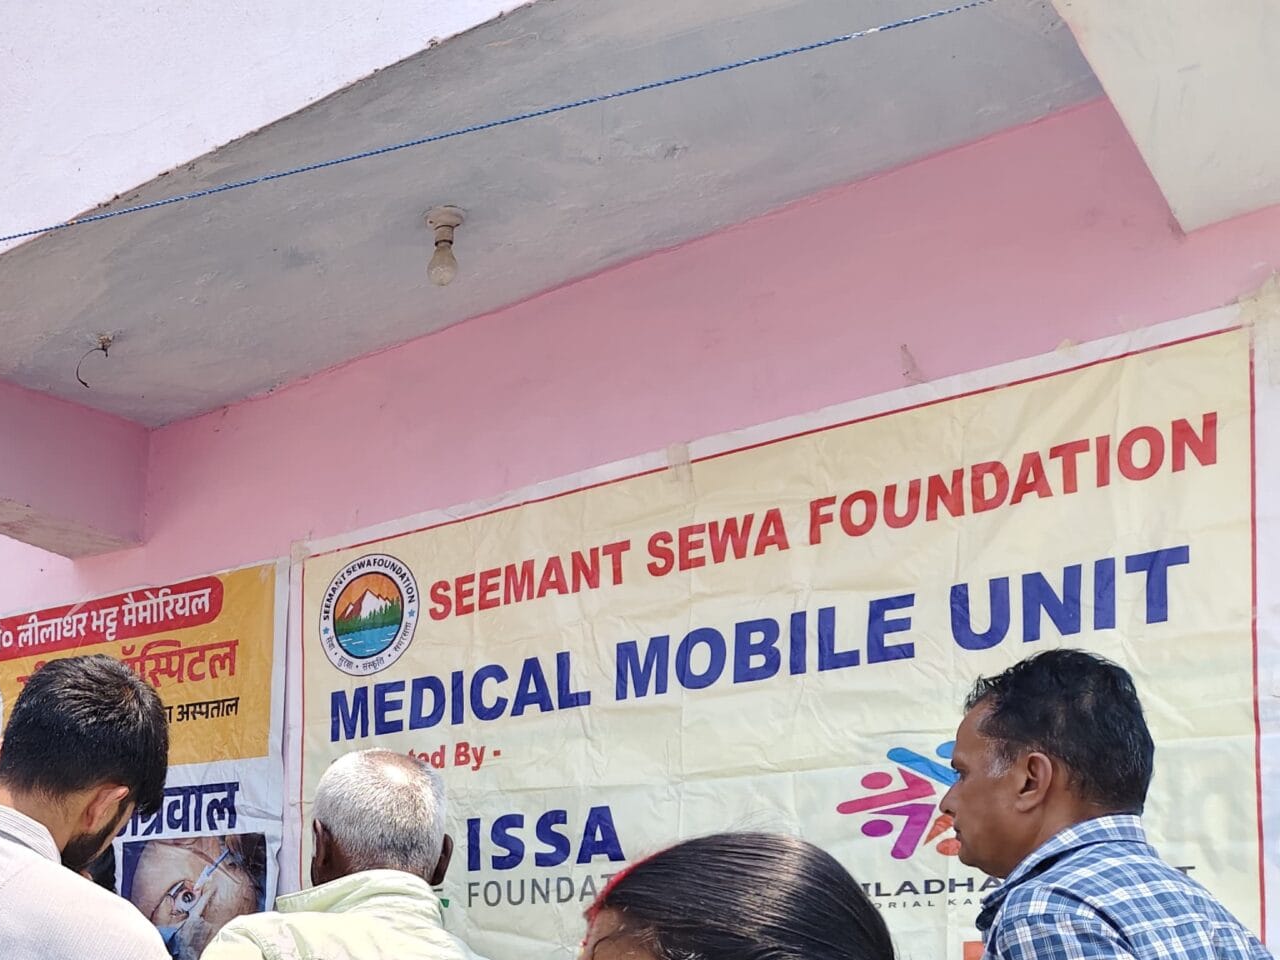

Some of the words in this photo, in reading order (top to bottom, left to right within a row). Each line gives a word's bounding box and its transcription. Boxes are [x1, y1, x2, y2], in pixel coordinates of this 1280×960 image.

[429, 540, 630, 620] SEEMANT
[647, 508, 789, 578] SEWA
[810, 412, 1218, 545] FOUNDATION
[17, 613, 88, 648] लीलाधर
[91, 607, 118, 641] भट्ट
[122, 588, 211, 626] मैमोरियल
[323, 573, 347, 620] SEEMANT
[330, 651, 591, 742] MEDICAL
[615, 593, 915, 701] MOBILE
[950, 545, 1190, 651] UNIT
[177, 697, 240, 723] अस्पताल
[454, 741, 486, 771] By
[467, 805, 626, 872] ISSA
[861, 877, 1004, 897] ILADHA
[872, 900, 935, 909] ORIAL
